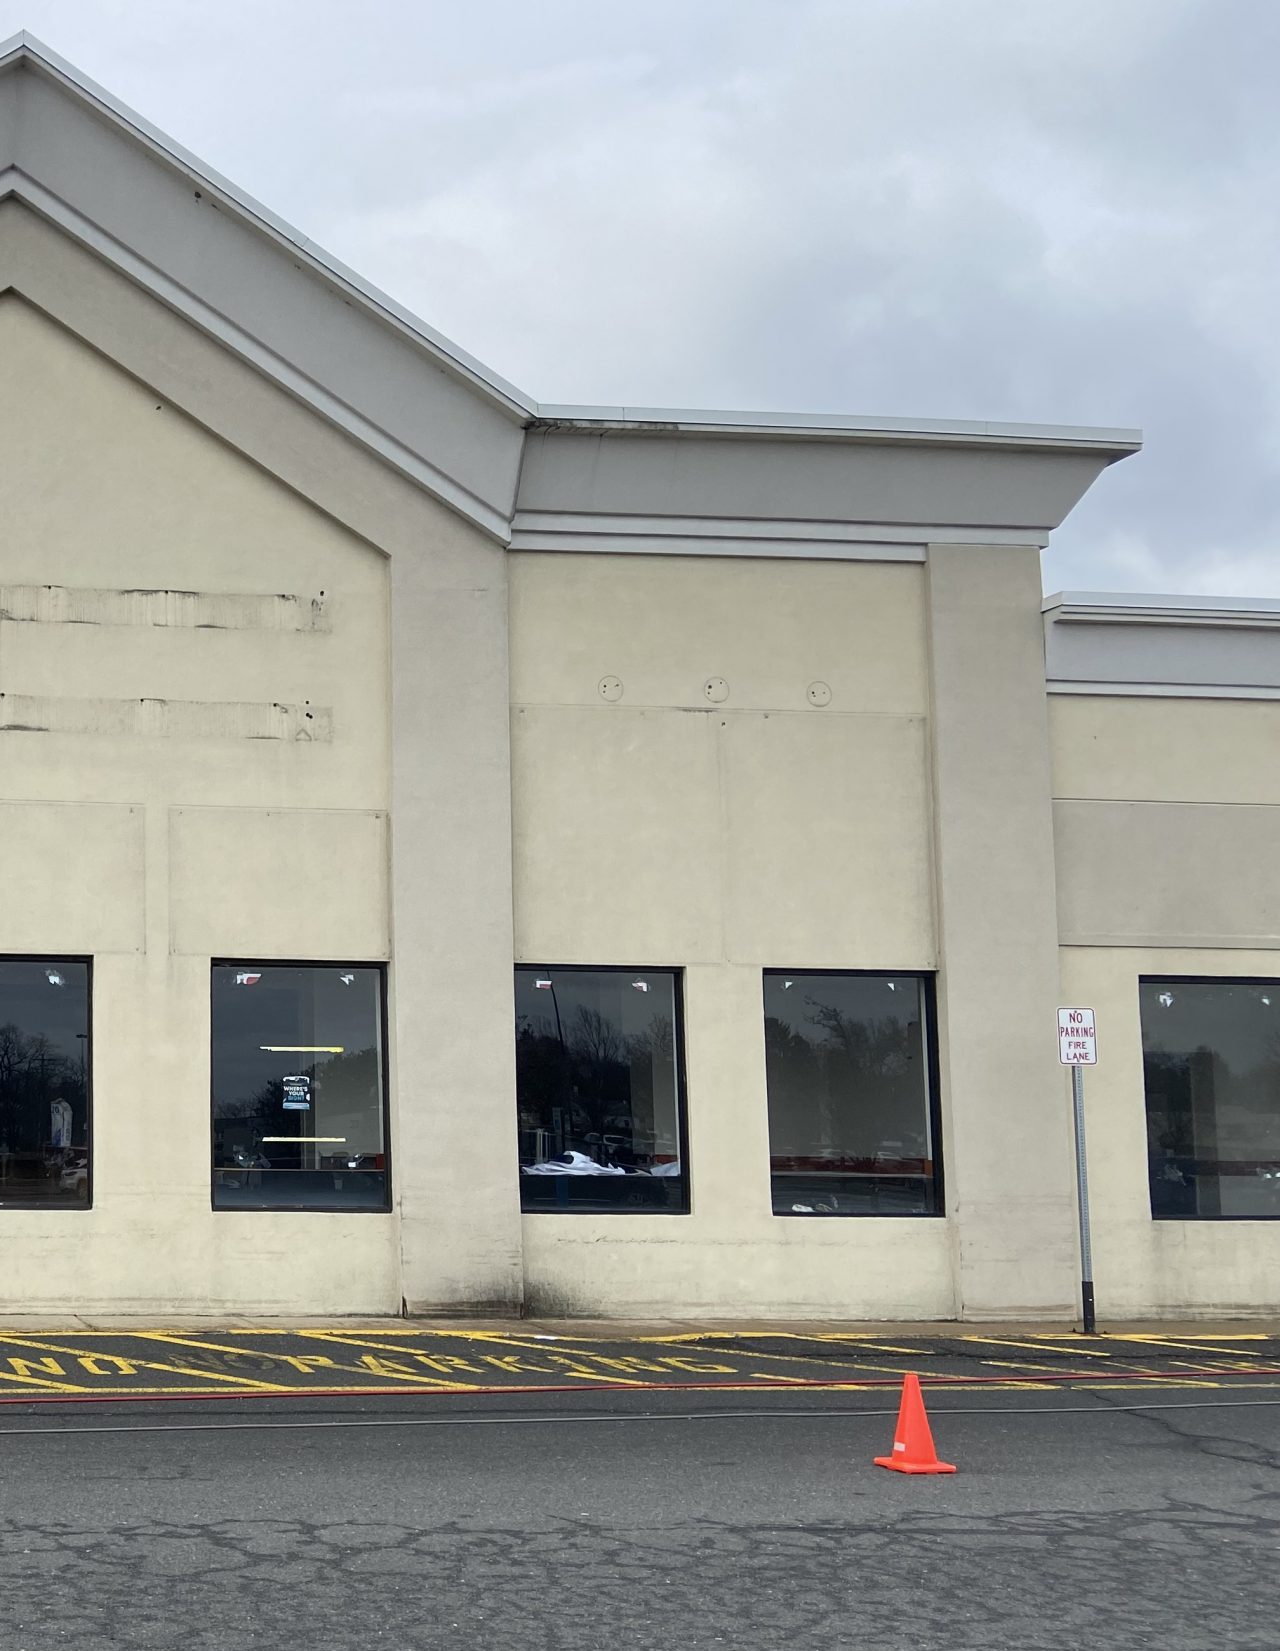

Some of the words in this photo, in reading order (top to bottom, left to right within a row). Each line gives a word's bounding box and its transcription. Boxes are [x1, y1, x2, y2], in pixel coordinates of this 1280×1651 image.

[1069, 1012, 1083, 1024] NO
[1060, 1026, 1094, 1037] PARKING
[1068, 1041, 1087, 1050] FIRE
[1066, 1052, 1090, 1060] LANE
[7, 1356, 138, 1376] NO
[284, 1355, 738, 1374] PARKING
